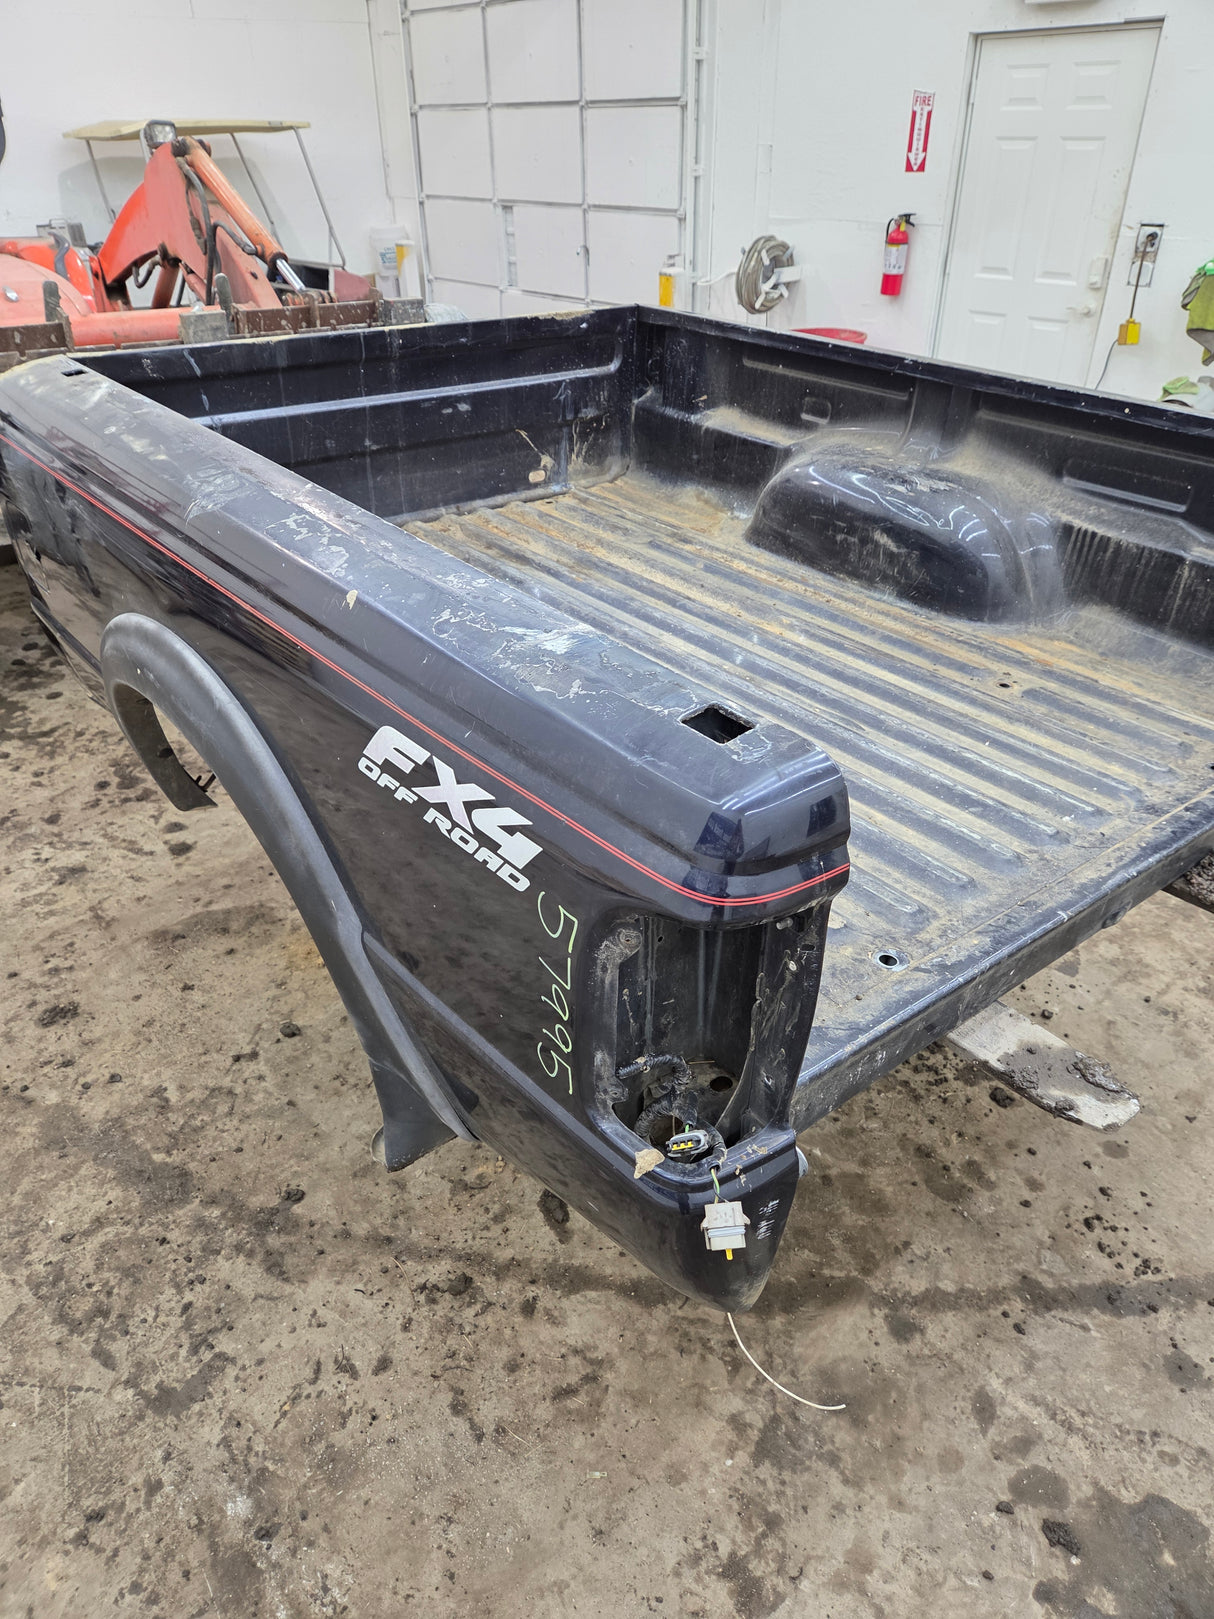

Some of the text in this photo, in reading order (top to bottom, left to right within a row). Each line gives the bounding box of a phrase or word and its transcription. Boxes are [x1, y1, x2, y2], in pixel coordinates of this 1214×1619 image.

[914, 95, 932, 106] FIRE
[357, 756, 531, 892] OFF ROAD
[362, 725, 544, 870] FX4
[537, 891, 579, 1095] 57995
